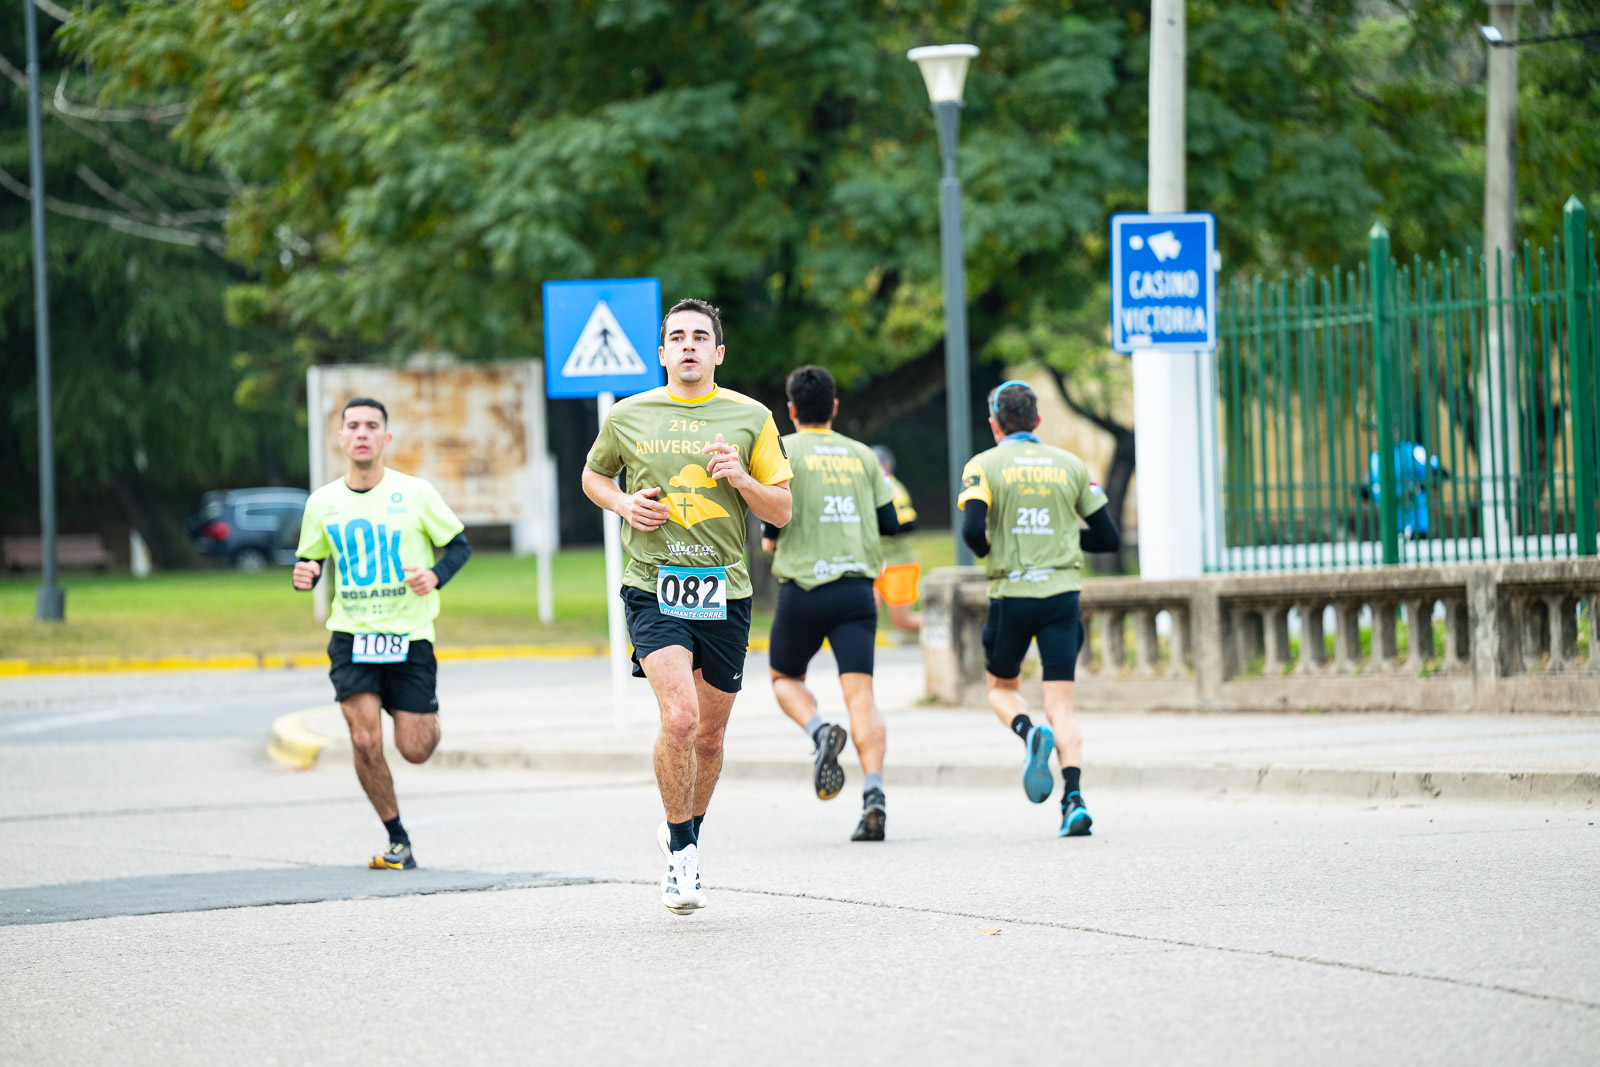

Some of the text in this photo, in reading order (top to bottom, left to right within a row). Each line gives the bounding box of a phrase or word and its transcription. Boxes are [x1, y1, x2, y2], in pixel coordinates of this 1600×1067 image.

[1129, 270, 1199, 299] CASINO
[1122, 306, 1207, 334] VICTORIA
[668, 419, 707, 433] 216°
[1002, 465, 1067, 485] VICTORIA
[823, 495, 855, 515] 216
[1016, 507, 1050, 526] 216
[342, 586, 407, 599] ROSARIO
[661, 574, 720, 609] 082
[663, 608, 724, 618] DIAMANTE CORRE
[360, 633, 403, 655] 108
